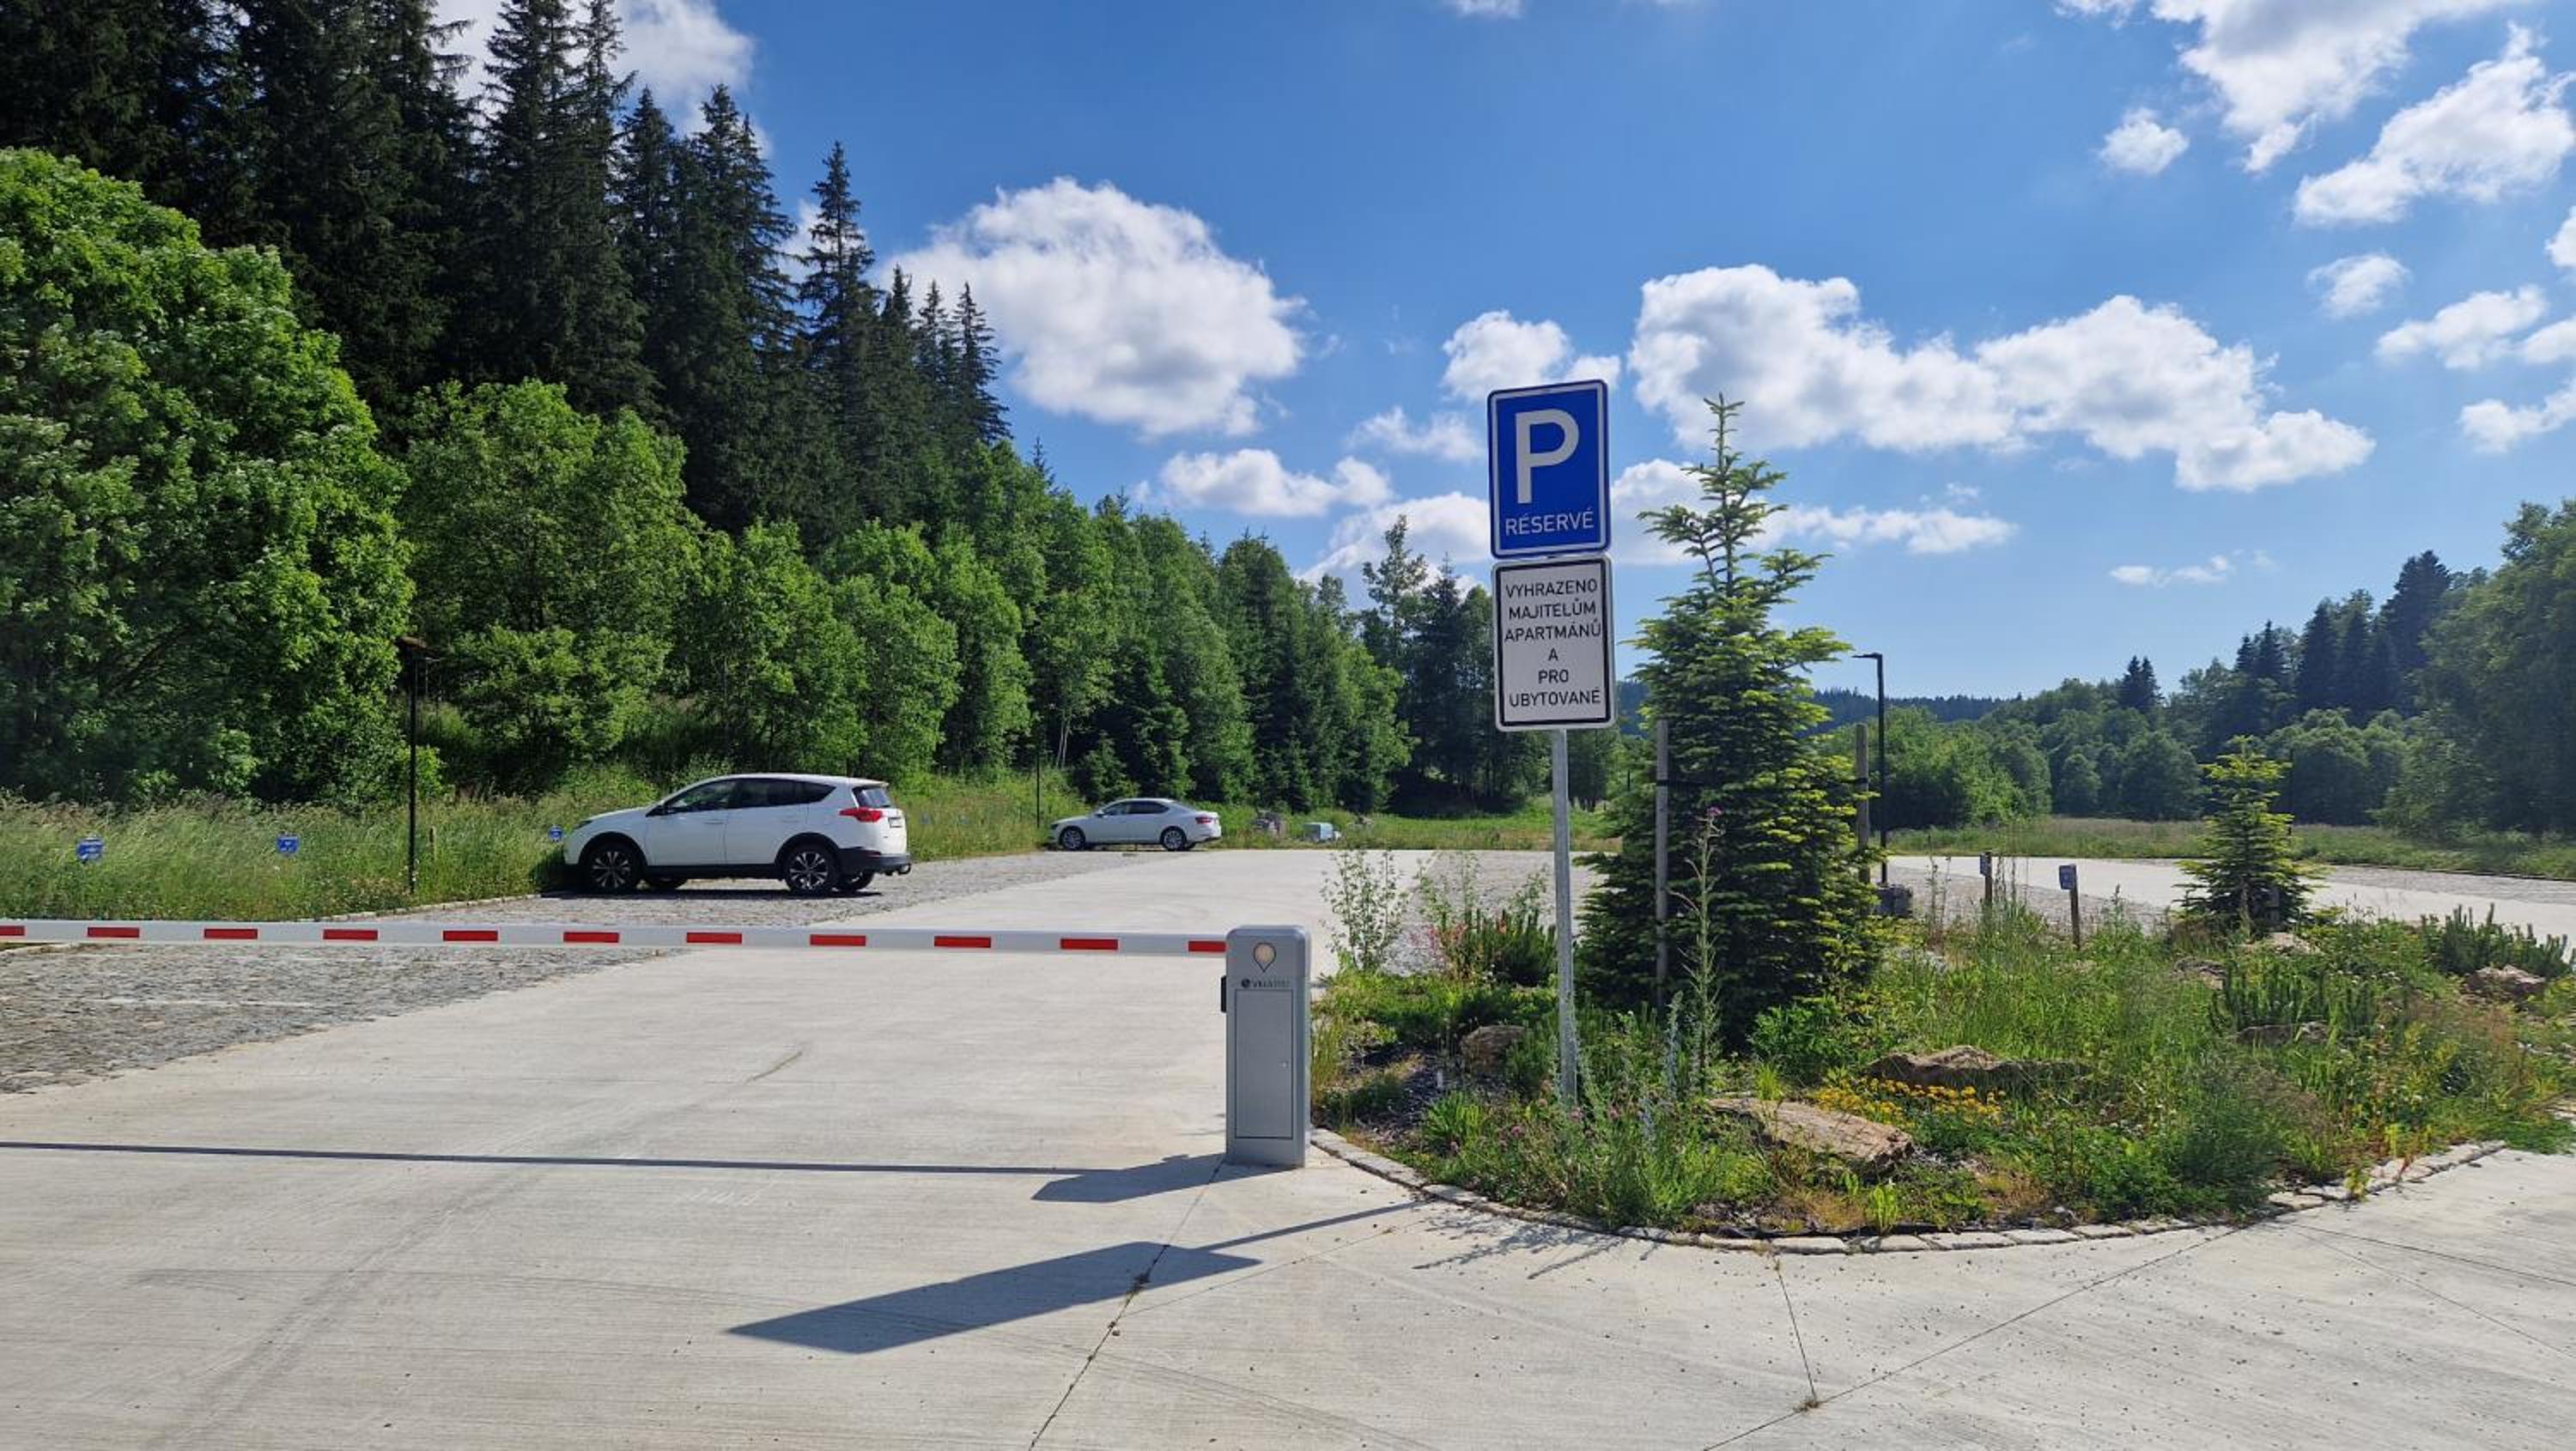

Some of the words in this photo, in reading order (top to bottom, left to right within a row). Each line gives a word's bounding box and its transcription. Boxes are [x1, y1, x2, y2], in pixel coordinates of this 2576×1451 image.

[1515, 409, 1579, 504] P
[1505, 507, 1595, 536] RÉSERVÉ
[1505, 578, 1598, 598] VYHRAZENO
[1509, 598, 1596, 621] MAJITELŮM
[1504, 618, 1601, 642] APARTMÁNŮ
[1548, 647, 1558, 661] A
[1538, 669, 1569, 684] PRO
[1509, 687, 1601, 707] UBYTOVANÉ
